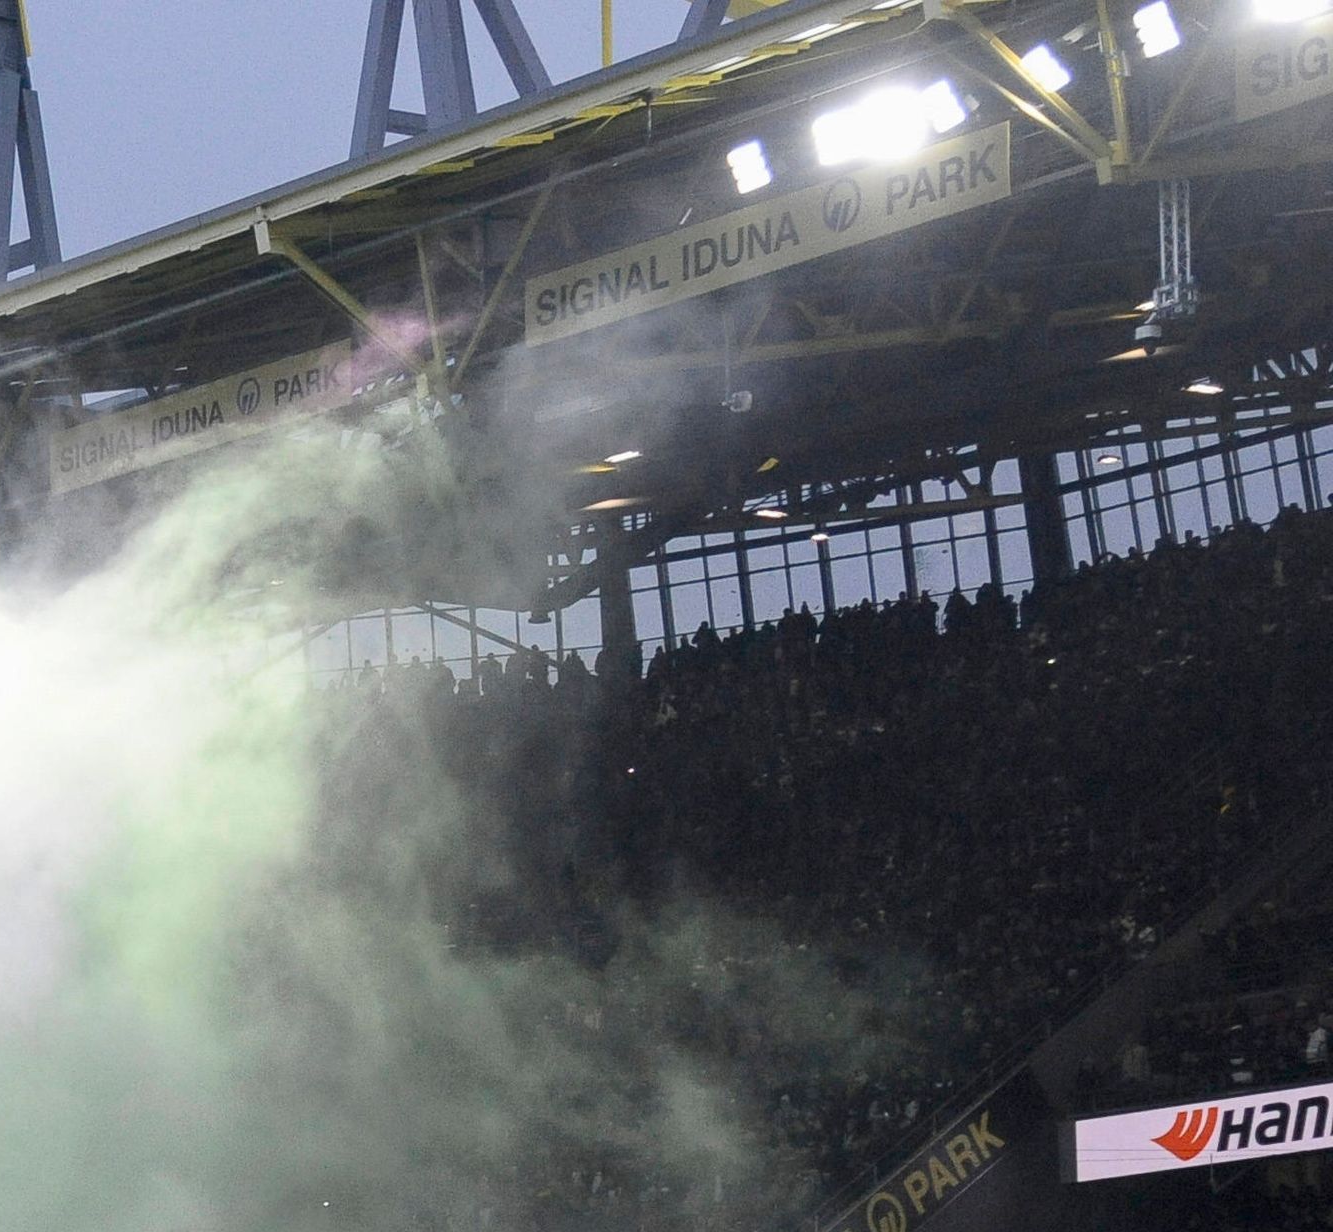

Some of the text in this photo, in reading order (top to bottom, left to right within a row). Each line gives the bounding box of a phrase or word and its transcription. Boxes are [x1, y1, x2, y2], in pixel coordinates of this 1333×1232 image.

[535, 143, 997, 327] SIGNAL IDUNA PARK
[151, 399, 225, 445] IDUNA
[274, 362, 341, 406] PARK
[903, 1110, 1006, 1216] PARK
